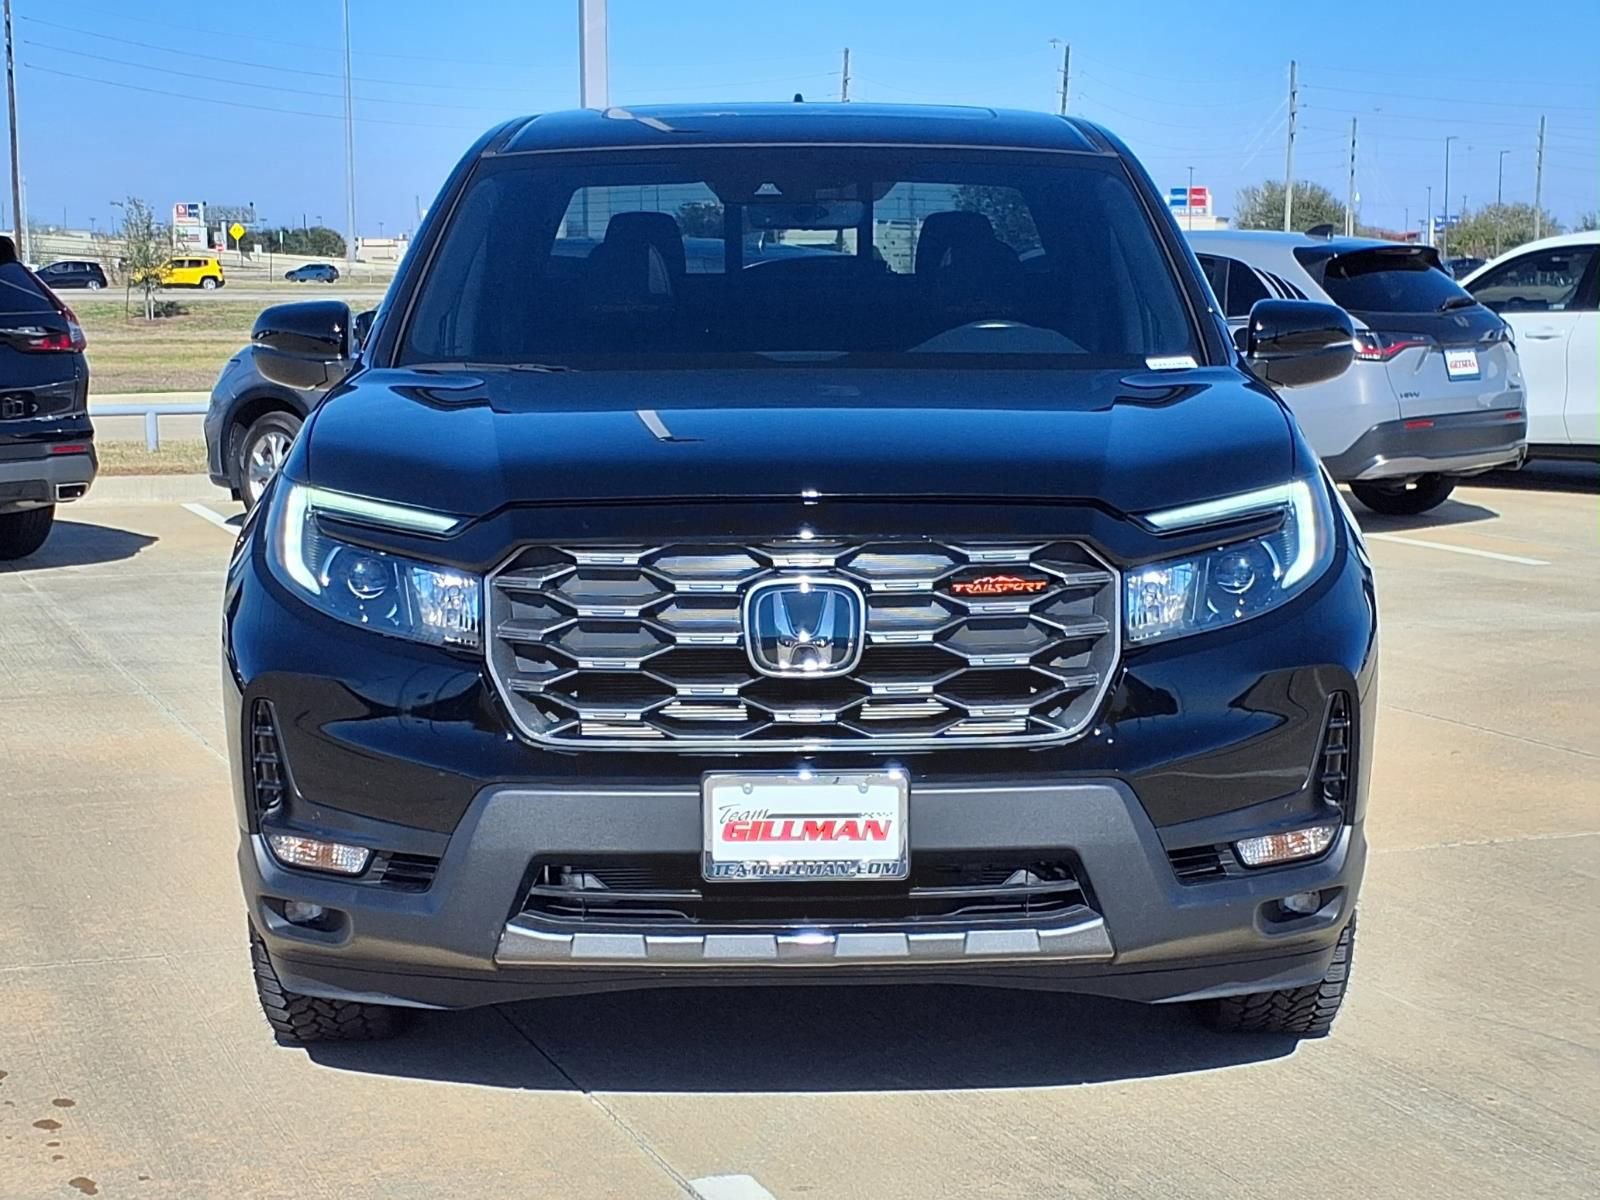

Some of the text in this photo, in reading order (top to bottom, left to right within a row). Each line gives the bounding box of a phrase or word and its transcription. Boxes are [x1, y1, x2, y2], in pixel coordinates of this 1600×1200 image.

[952, 581, 1047, 594] TRAILSPORT
[717, 803, 770, 825] Team
[721, 819, 893, 842] GILLMAN
